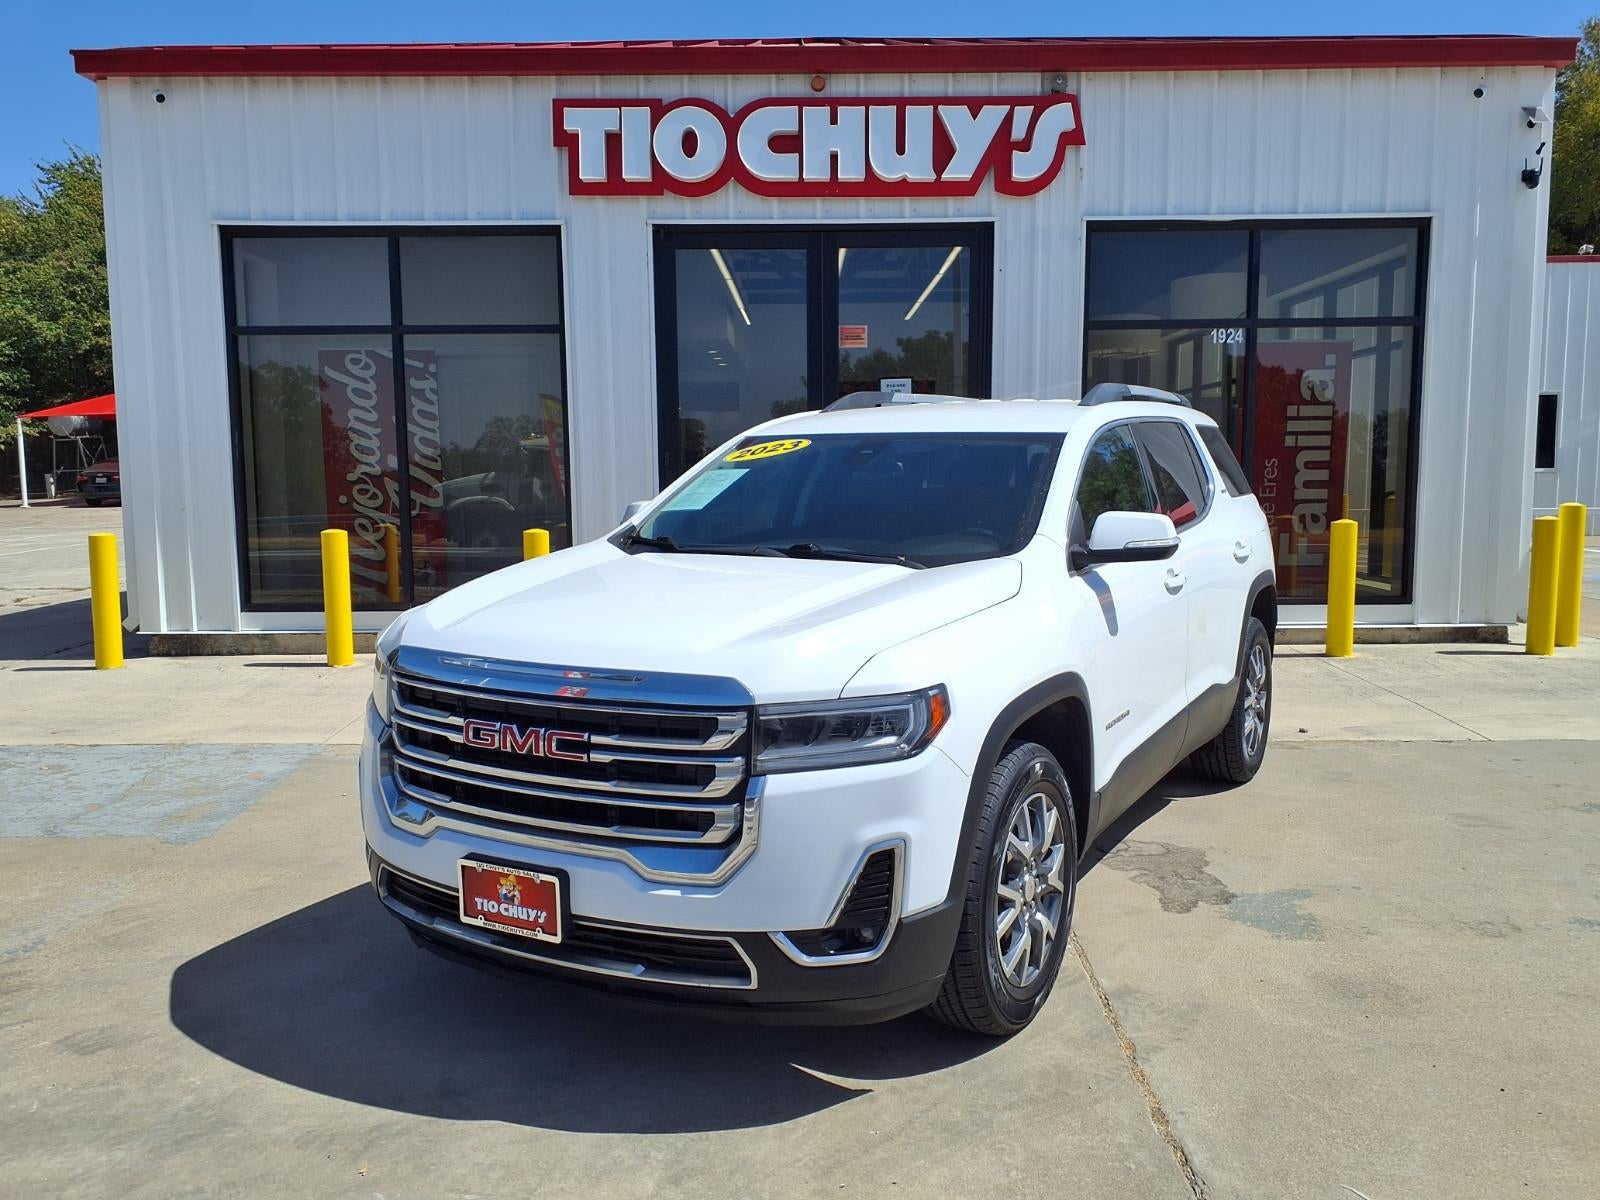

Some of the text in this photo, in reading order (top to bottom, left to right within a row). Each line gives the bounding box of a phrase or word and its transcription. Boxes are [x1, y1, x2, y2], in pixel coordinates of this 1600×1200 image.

[563, 102, 1076, 183] TIO CHUY'S
[1211, 328, 1244, 344] 1924
[731, 440, 804, 460] 2023
[1279, 353, 1337, 566] Familia.
[1260, 458, 1278, 497] Eres
[463, 718, 589, 763] GMC
[523, 871, 540, 879] SALES
[474, 897, 547, 923] TIO CHUY'S
